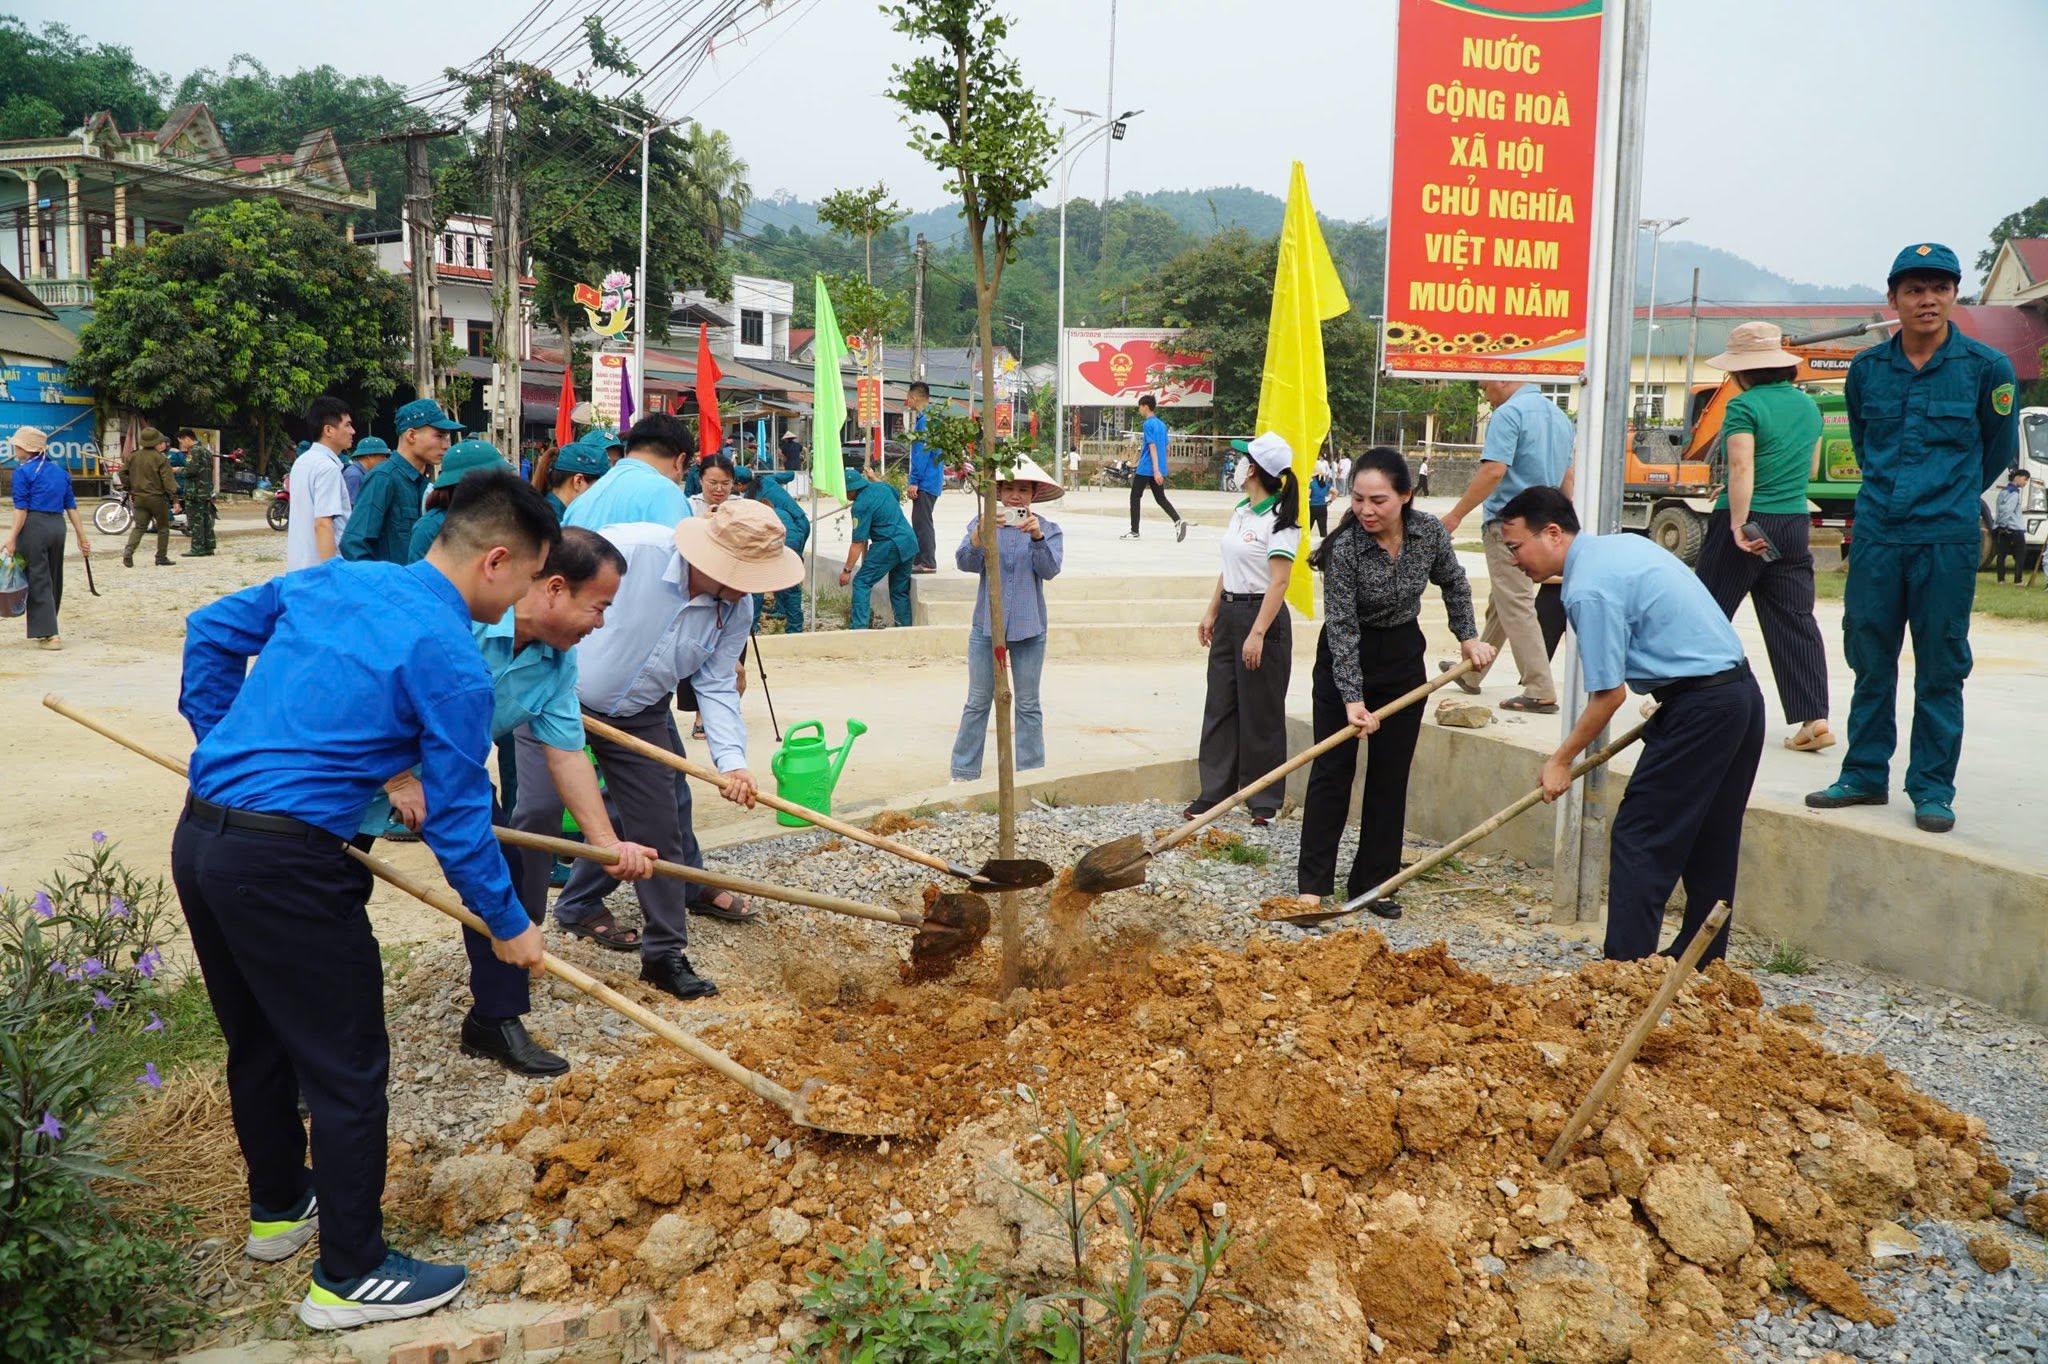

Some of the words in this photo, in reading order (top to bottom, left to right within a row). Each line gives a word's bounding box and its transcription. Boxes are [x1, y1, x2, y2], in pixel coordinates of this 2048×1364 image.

[1462, 34, 1541, 74] NƯỚC
[1427, 79, 1506, 123] CỘNG
[1515, 91, 1571, 126] HOÀ
[1450, 132, 1488, 168] XÃ
[1497, 136, 1544, 178] HỘI
[1422, 174, 1480, 216] CHỦ
[1489, 188, 1575, 223] NGHĨA
[1425, 229, 1486, 271] VIỆT
[1493, 237, 1559, 269] NAM
[1409, 277, 1496, 314] MUÔN
[1504, 282, 1570, 318] NĂM
[1811, 359, 1852, 369] DEVELON
